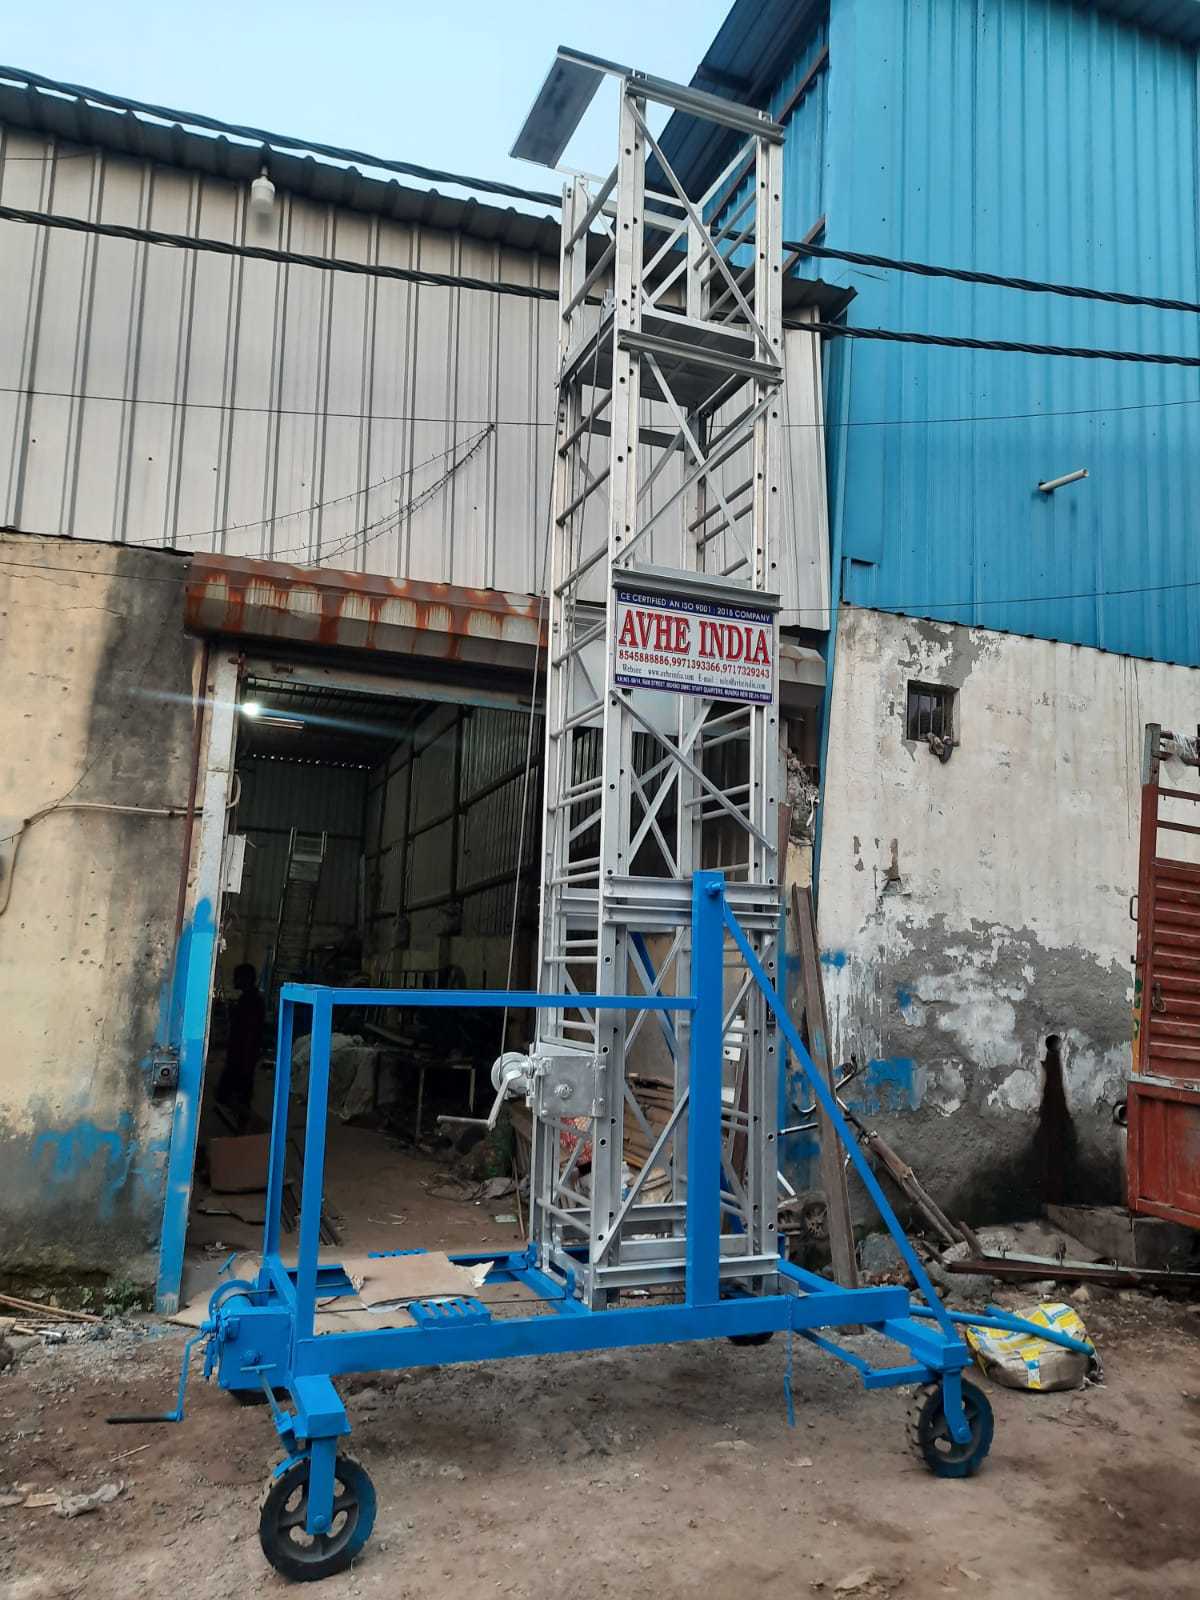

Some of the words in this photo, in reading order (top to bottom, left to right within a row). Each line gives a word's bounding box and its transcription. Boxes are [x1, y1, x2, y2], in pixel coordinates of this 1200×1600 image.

[620, 592, 631, 601] CE
[632, 594, 667, 606] CERTIFIED
[669, 600, 681, 608] AN
[681, 602, 694, 610] ISO
[734, 609, 770, 621] COMPANY
[618, 609, 691, 655] AVHE
[698, 620, 770, 666] INDIA
